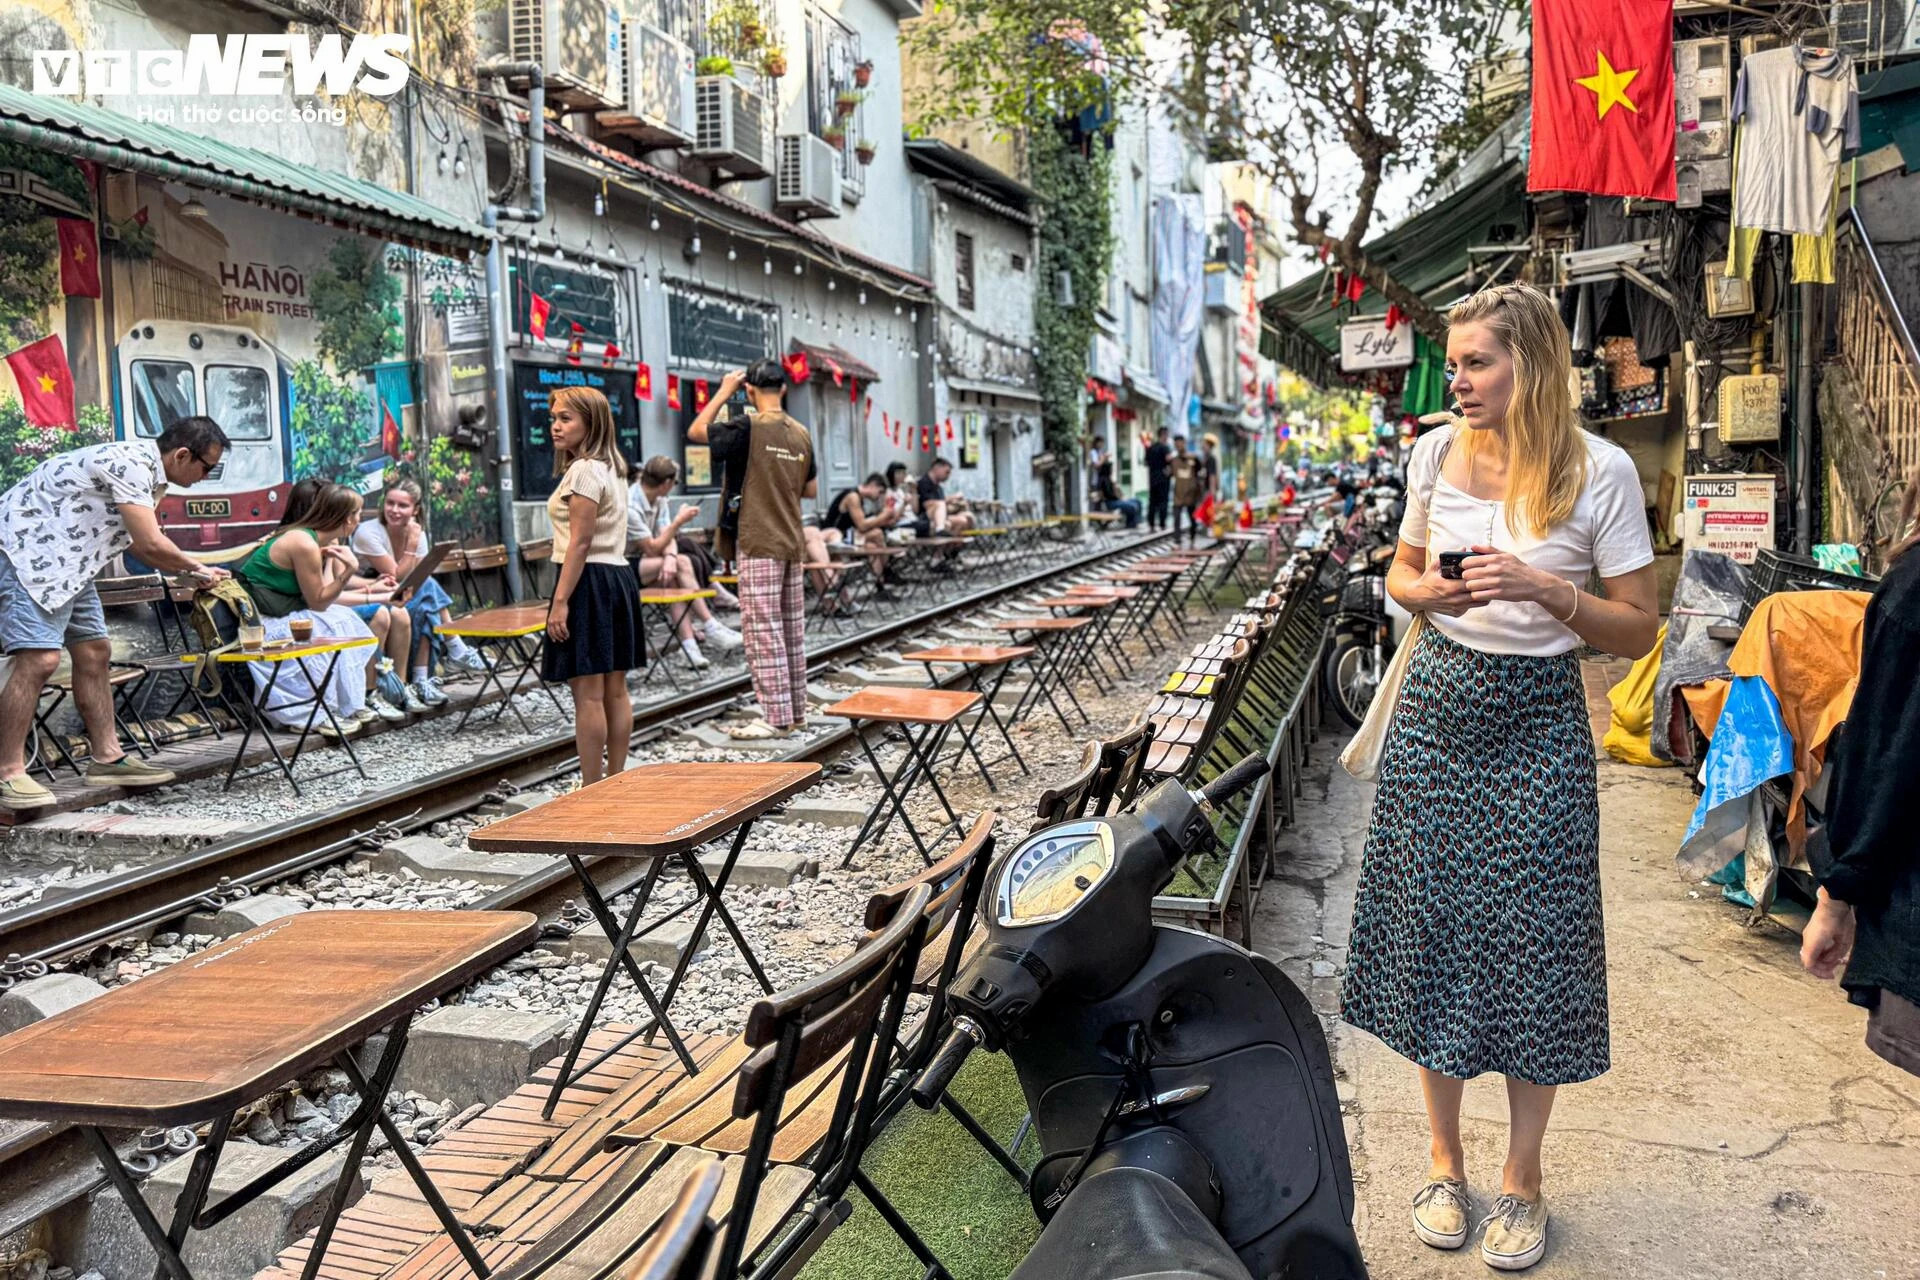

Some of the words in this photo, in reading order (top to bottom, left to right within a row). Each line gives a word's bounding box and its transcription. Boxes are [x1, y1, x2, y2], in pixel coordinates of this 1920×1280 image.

[222, 294, 264, 313] TRAIN
[265, 300, 315, 319] STREET
[1353, 330, 1399, 357] Lyly
[1688, 483, 1735, 496] FUNK25
